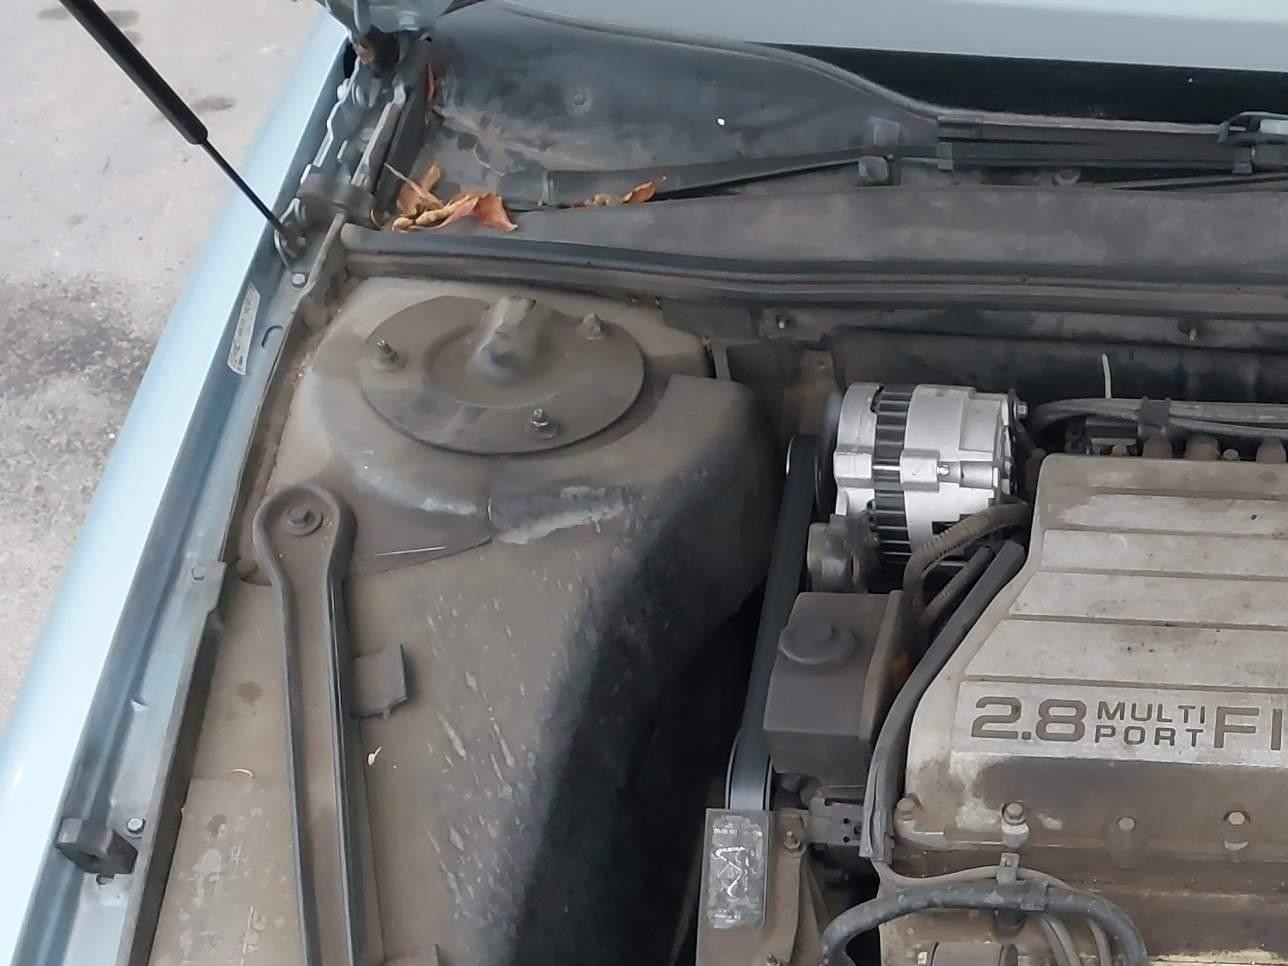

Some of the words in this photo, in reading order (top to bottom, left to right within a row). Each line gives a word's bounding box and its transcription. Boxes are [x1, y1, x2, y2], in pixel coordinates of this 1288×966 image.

[970, 696, 1087, 742] 2.8
[1097, 701, 1206, 724] MULTI
[1213, 706, 1283, 751] FI
[1095, 724, 1203, 747] PORT
